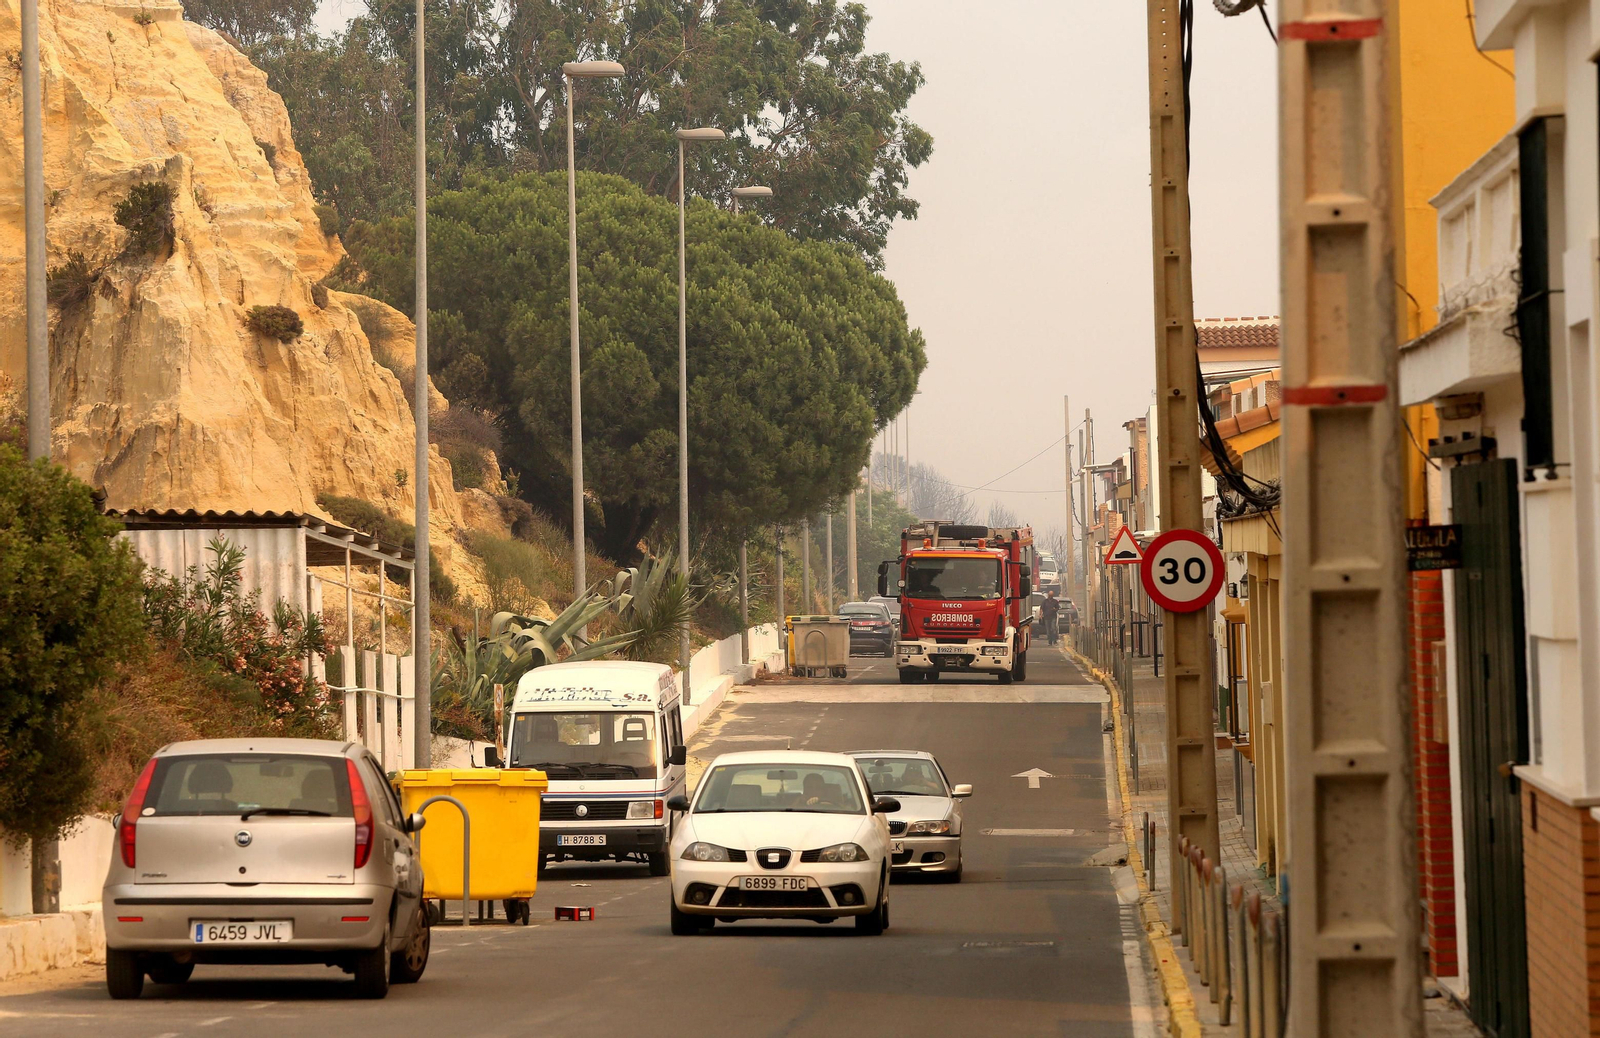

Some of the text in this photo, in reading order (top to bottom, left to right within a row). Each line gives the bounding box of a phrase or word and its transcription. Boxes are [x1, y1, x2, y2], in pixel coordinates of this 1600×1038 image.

[1159, 557, 1206, 585] 30
[598, 835, 604, 844] S
[745, 877, 806, 890] 6899 FDC
[208, 925, 282, 941] 6459 JVL
